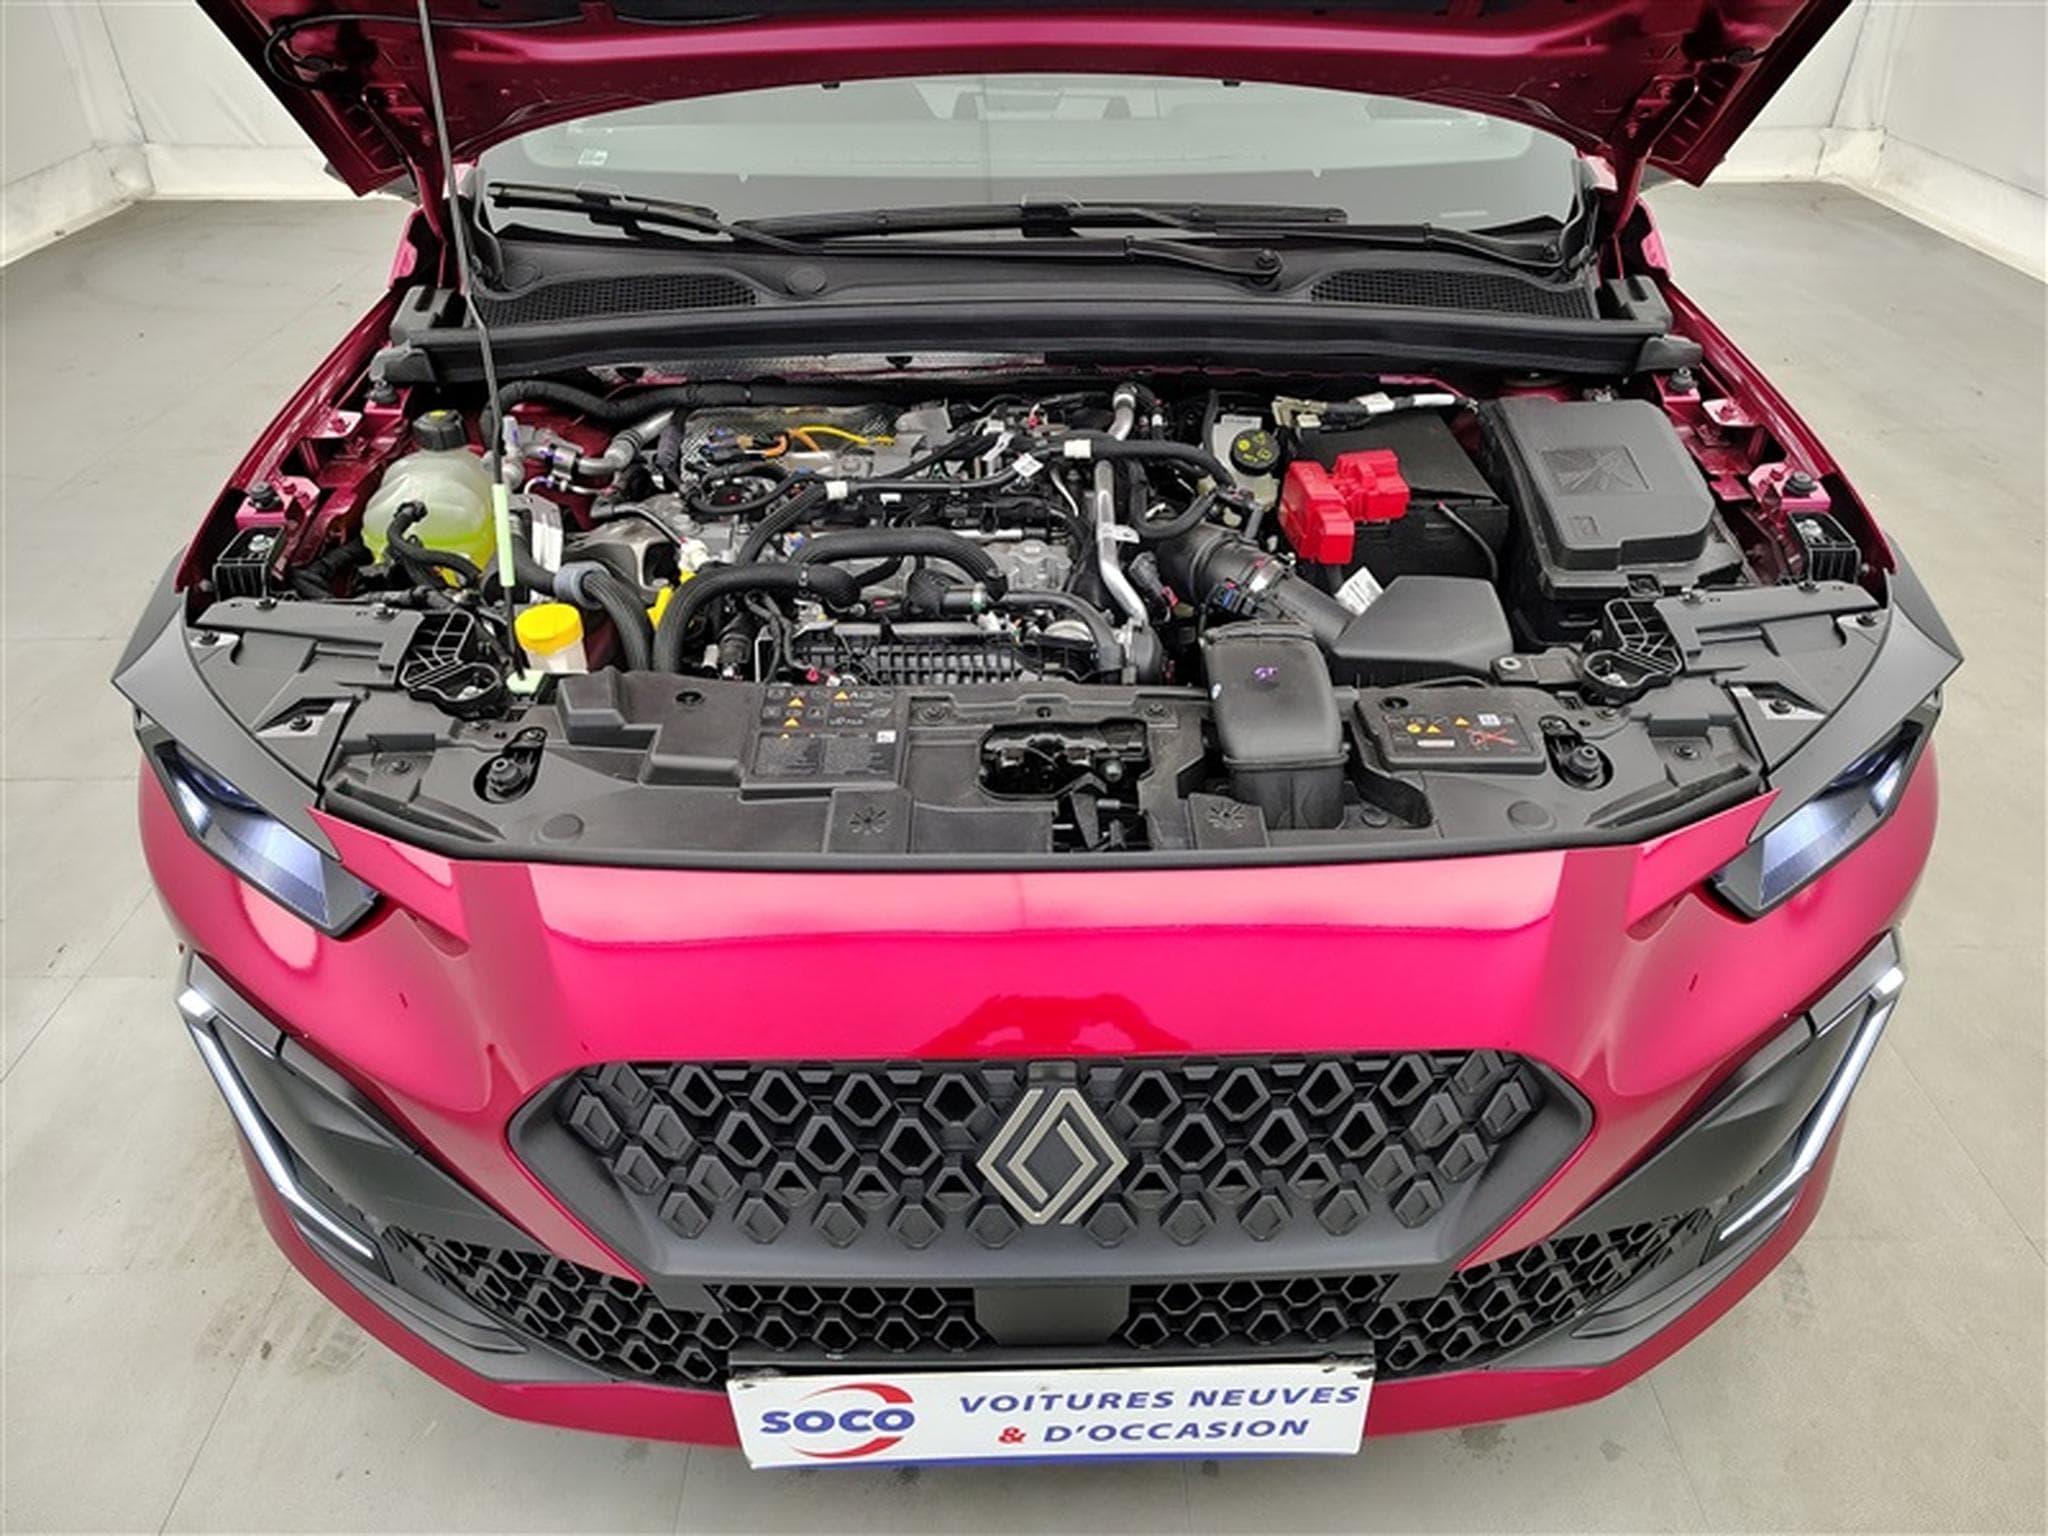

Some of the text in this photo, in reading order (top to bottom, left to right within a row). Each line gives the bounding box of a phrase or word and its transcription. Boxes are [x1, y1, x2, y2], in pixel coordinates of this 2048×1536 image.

[959, 1385, 1360, 1414] VOITURES NEUVES
[761, 1408, 916, 1435] SOCO
[999, 1418, 1309, 1444] & D'OCCASION
